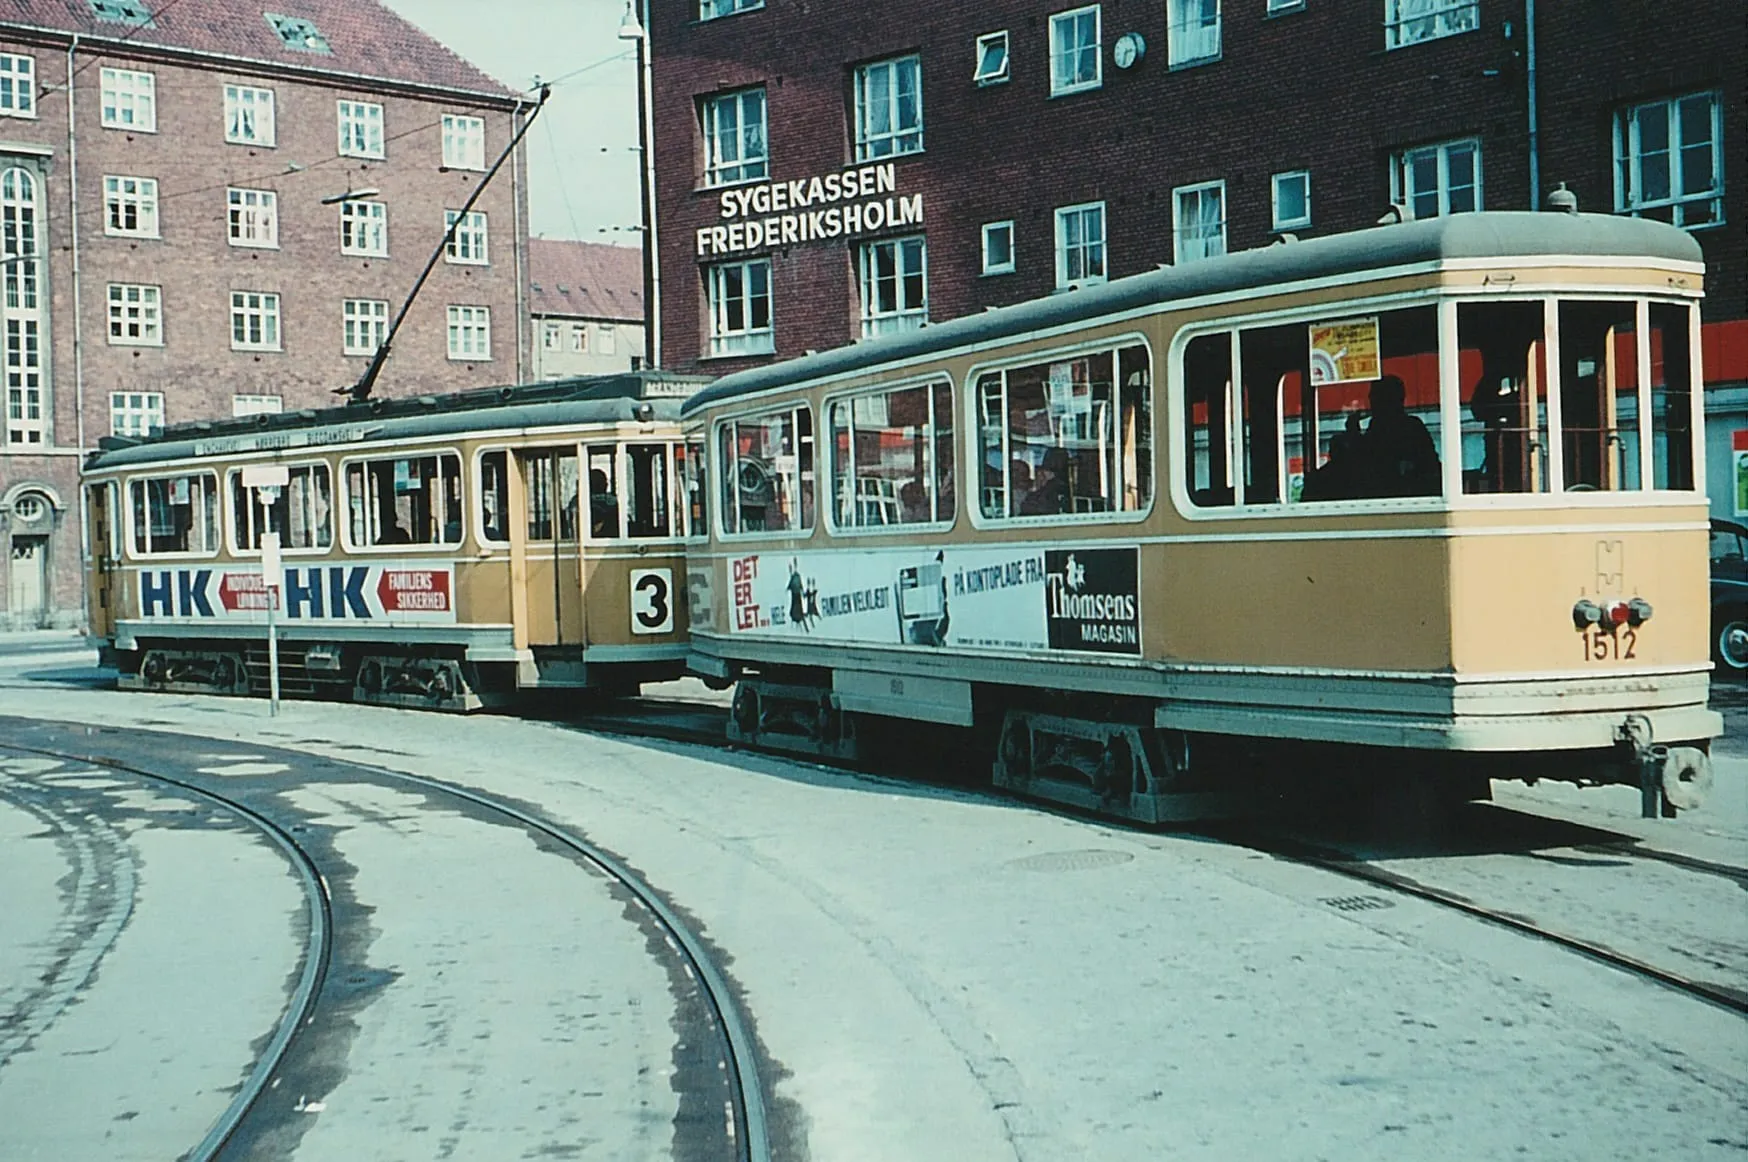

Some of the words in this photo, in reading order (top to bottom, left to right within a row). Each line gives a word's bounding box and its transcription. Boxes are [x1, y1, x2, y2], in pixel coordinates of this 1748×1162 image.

[720, 163, 896, 218] SYGEKASSEN
[696, 193, 924, 256] FREDERIKSHOLM
[285, 566, 372, 618] HK
[388, 573, 432, 591] FAMILIENS
[733, 555, 759, 583] DET
[821, 592, 852, 617] FAMILIEN
[954, 566, 967, 596] PÅ
[967, 560, 1023, 594] KONTOPLADE
[1025, 556, 1043, 584] FRA
[141, 570, 215, 616] HK
[396, 591, 446, 609] SIKKERHED
[635, 573, 668, 628] 3
[734, 582, 752, 606] ER
[1047, 573, 1135, 621] Thomsens
[1081, 624, 1137, 645] MAGASIN
[1582, 630, 1637, 661] 1512
